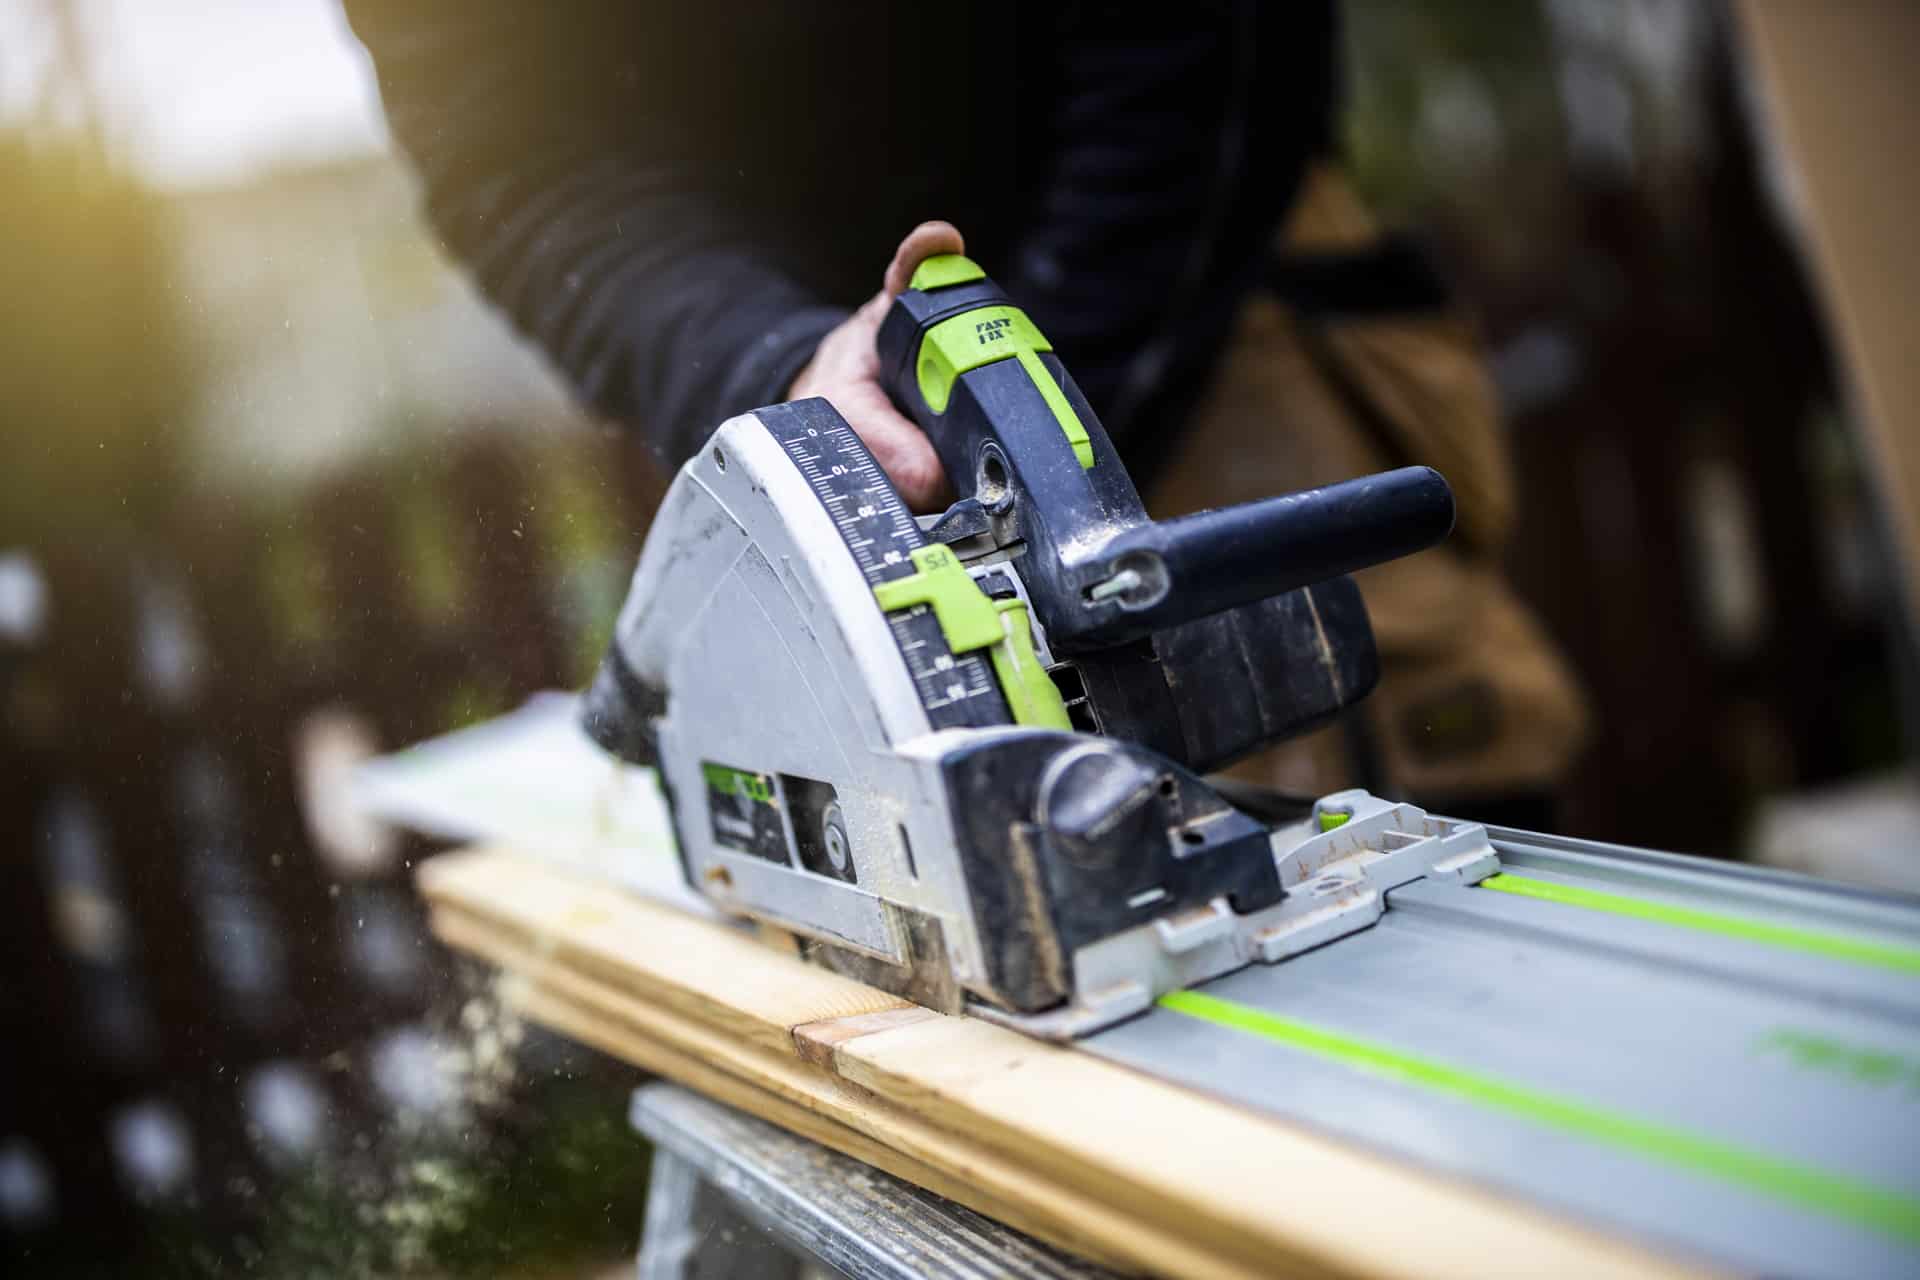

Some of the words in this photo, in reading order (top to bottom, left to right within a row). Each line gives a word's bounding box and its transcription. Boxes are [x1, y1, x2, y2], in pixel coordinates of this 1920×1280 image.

[975, 318, 1011, 333] FAST
[978, 329, 1004, 344] FIX
[807, 428, 818, 437] 0
[831, 465, 849, 476] 10
[858, 505, 877, 518] 20
